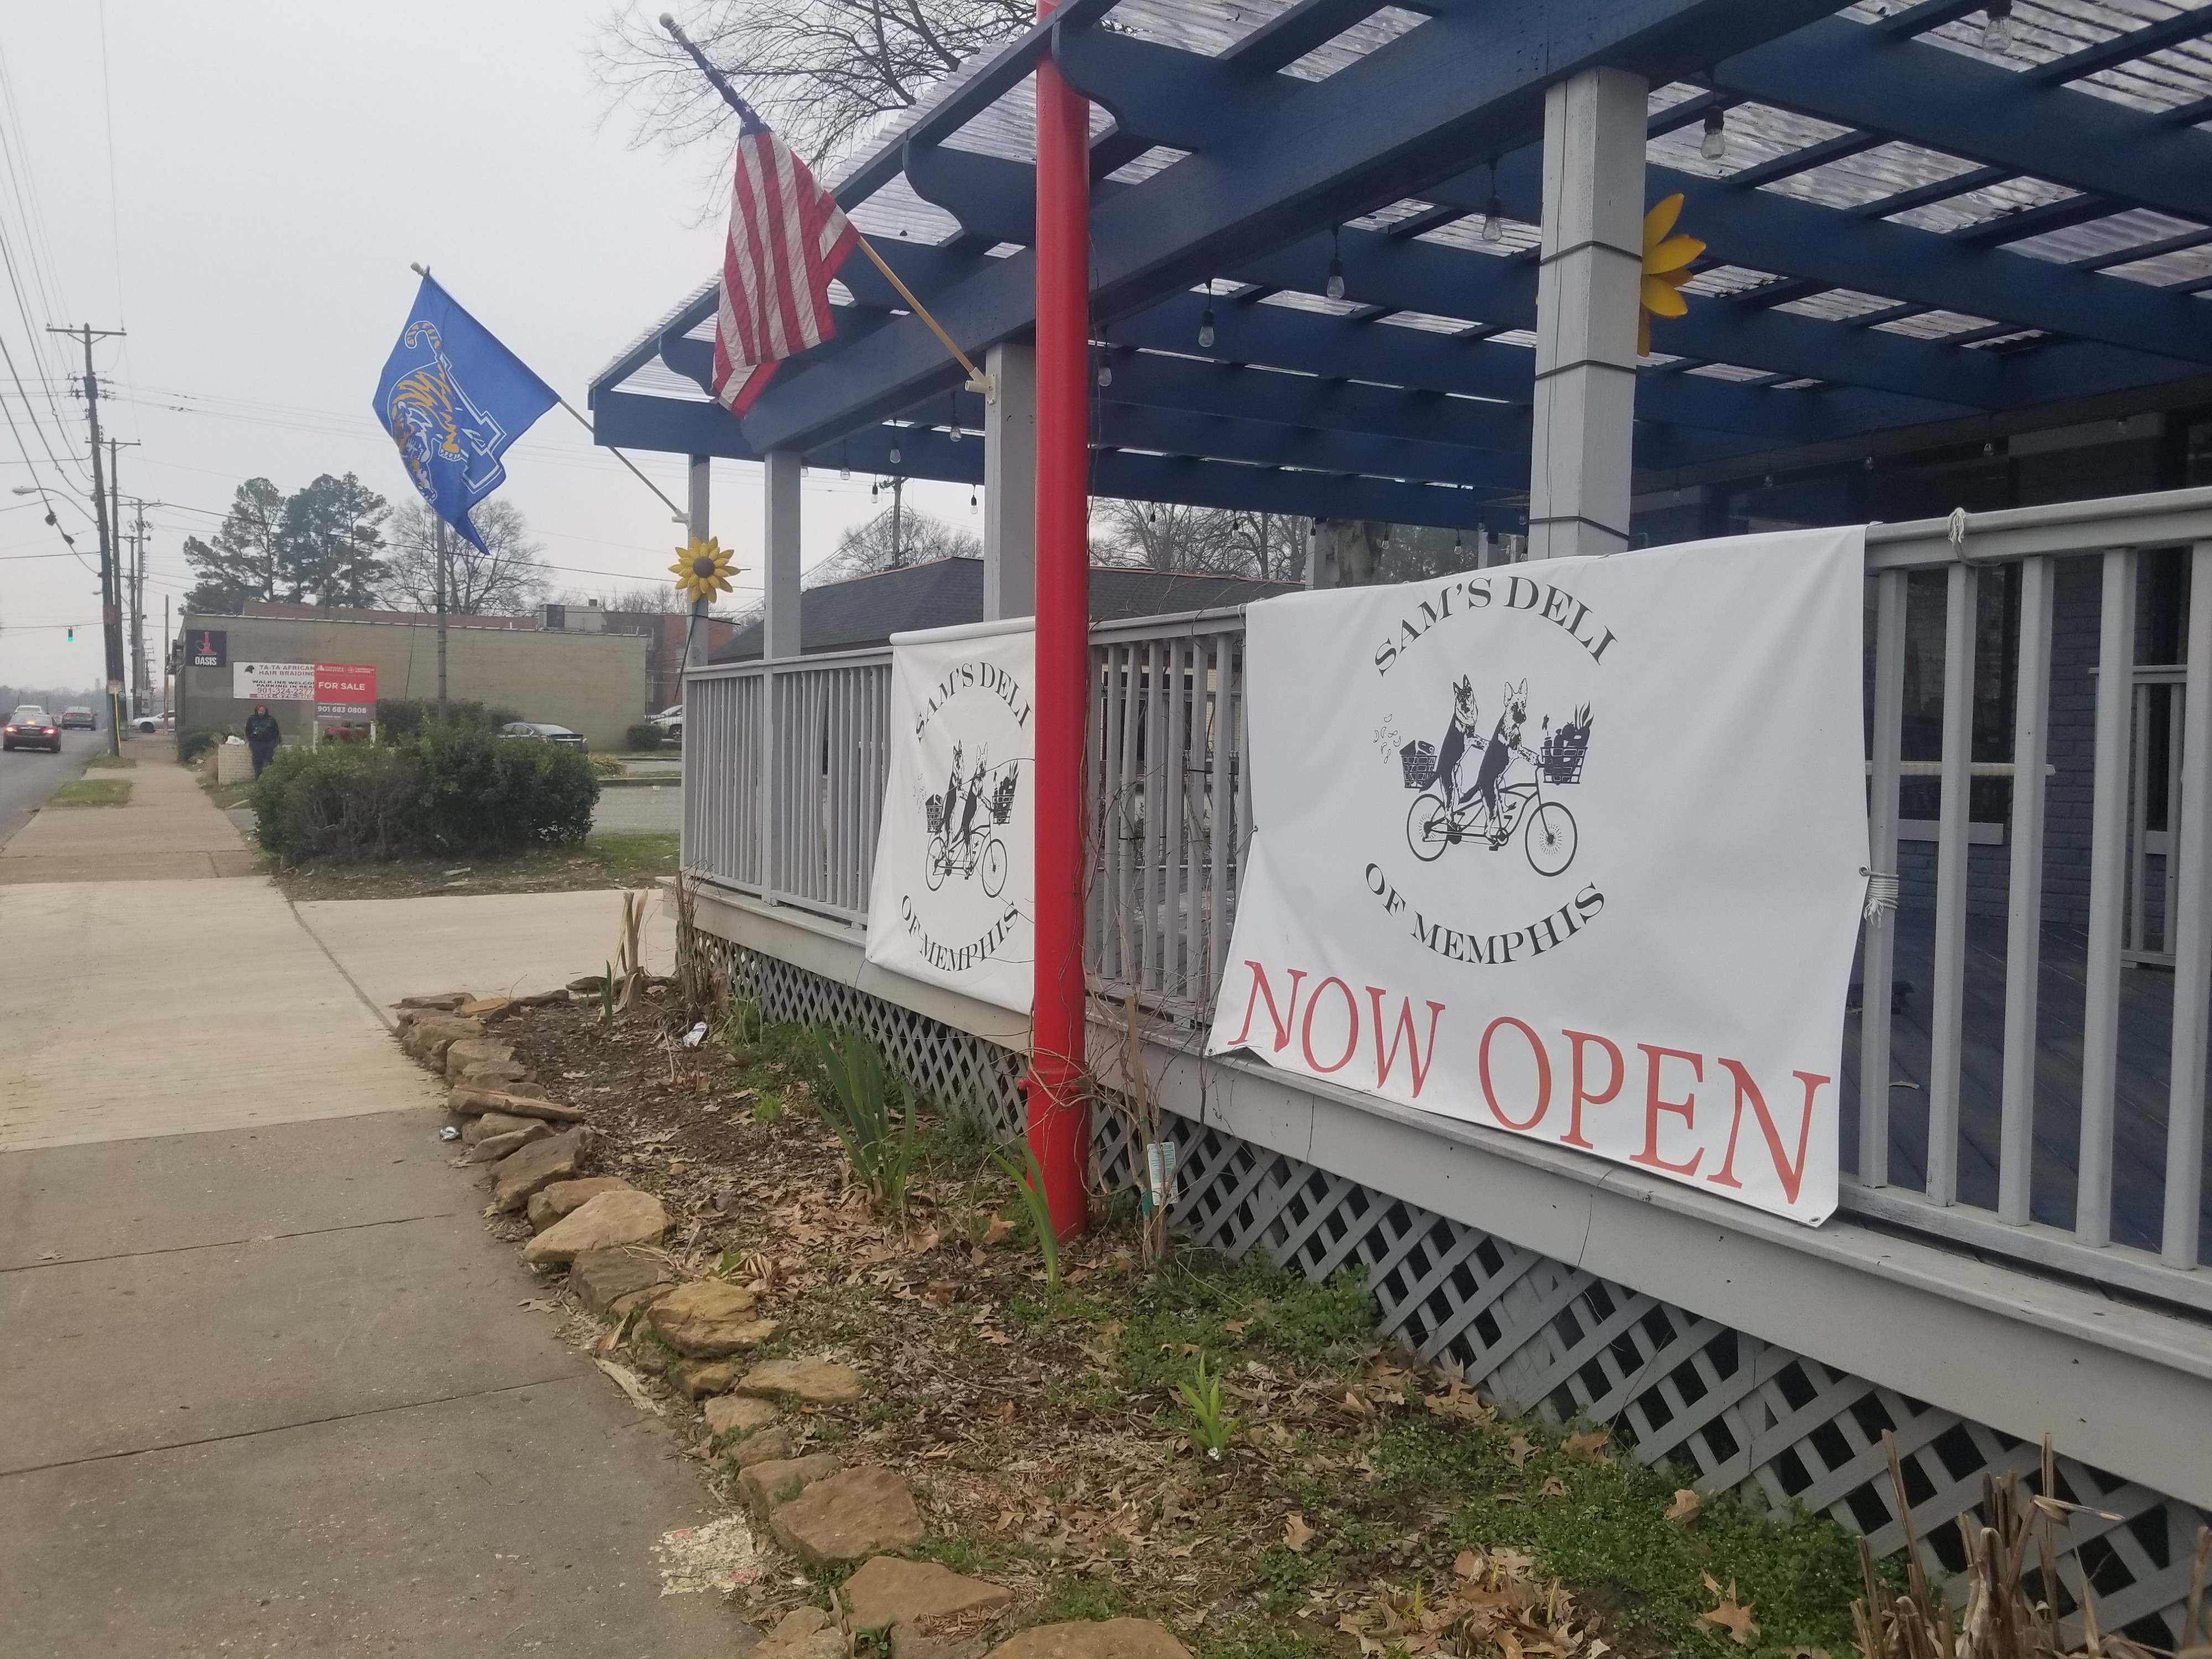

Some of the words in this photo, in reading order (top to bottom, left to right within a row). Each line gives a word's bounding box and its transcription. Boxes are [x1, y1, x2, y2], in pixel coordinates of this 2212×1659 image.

[195, 656, 217, 666] OASIS
[1374, 577, 1494, 677] SAM'S
[1504, 576, 1619, 665] DELI
[318, 681, 338, 690] FOR
[341, 682, 365, 691] SALE
[915, 663, 974, 743] SAM'S
[979, 662, 1032, 731] DELI
[901, 895, 921, 937] OF
[920, 901, 1018, 972] MEMPHIS
[1366, 862, 1406, 917] OF
[1411, 882, 1605, 964] MEMPHIS
[1228, 960, 1446, 1098] NOW
[1479, 1016, 1831, 1204] OPEN
